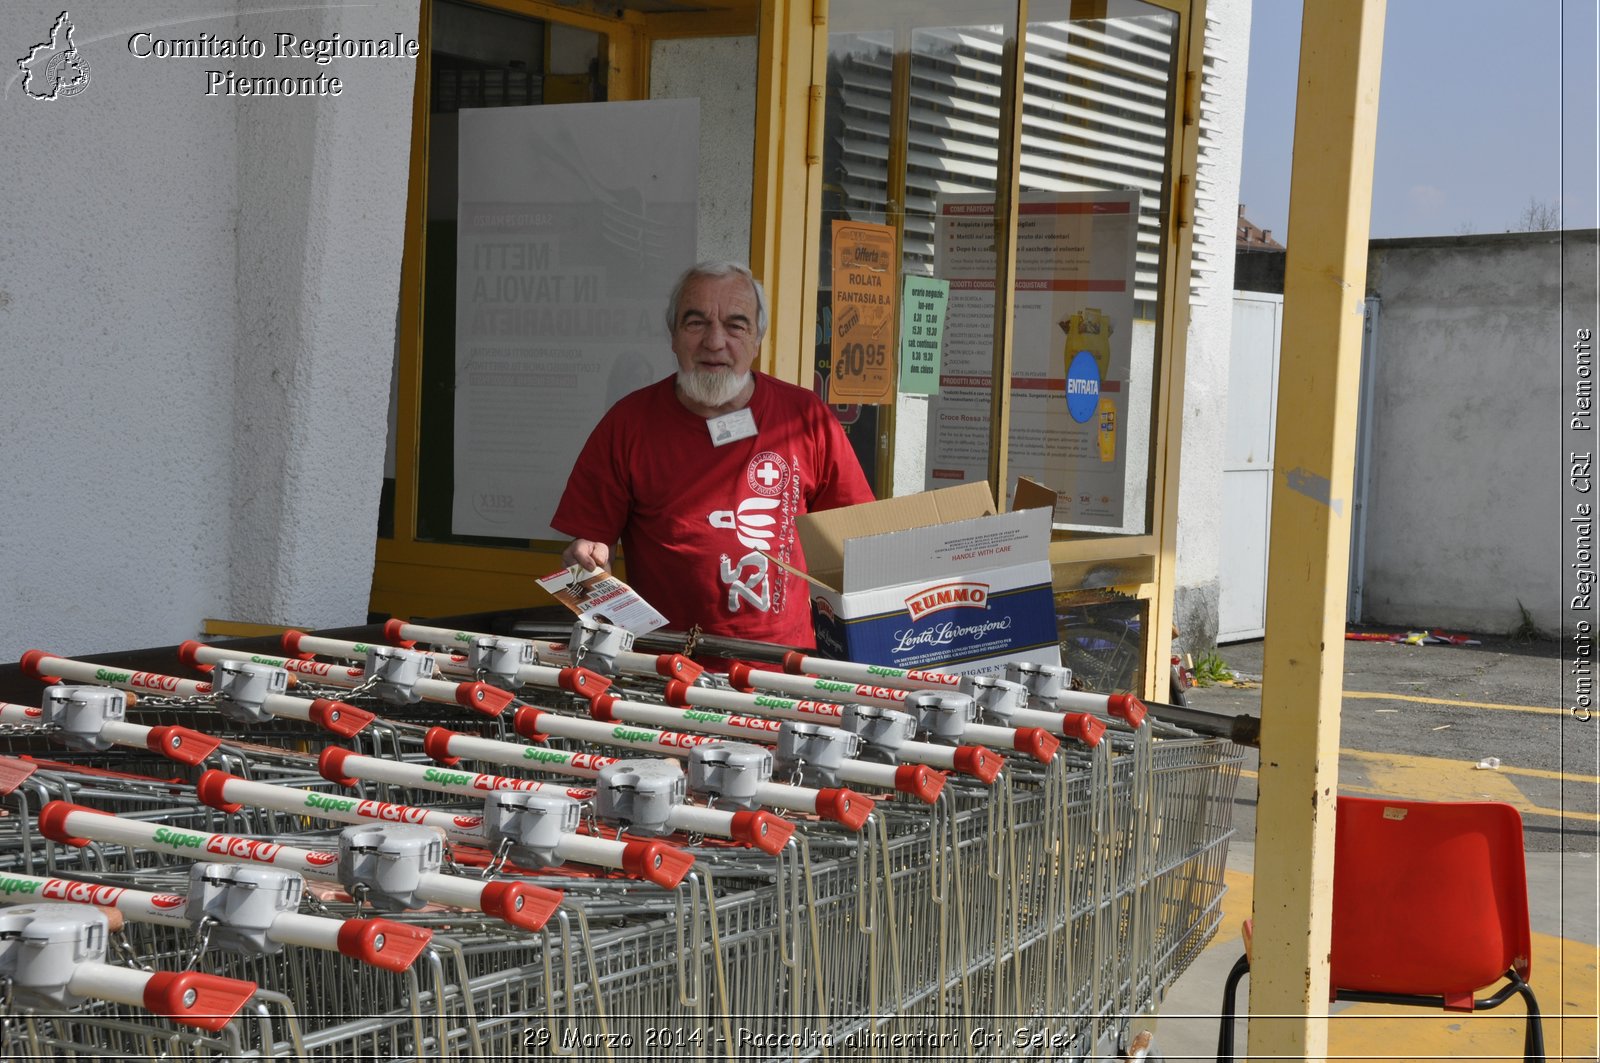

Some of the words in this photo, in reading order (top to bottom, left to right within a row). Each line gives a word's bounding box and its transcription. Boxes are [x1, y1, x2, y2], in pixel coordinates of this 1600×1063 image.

[855, 247, 879, 263] Offerta
[849, 273, 882, 287] ROLATA
[837, 291, 877, 304] FANTASIA
[838, 310, 860, 338] Carni
[1067, 378, 1099, 395] ENTRATA
[940, 413, 959, 421] Croce
[960, 414, 980, 422] Rossa
[778, 491, 790, 541] ITALIANA
[951, 551, 976, 561] HANDLE
[977, 548, 995, 558] WITH
[995, 545, 1011, 554] CARE
[580, 603, 591, 611] LA
[911, 588, 985, 615] RUMMO
[891, 627, 935, 654] Lenta
[930, 616, 1011, 646] Lavorazione
[95, 668, 131, 685] Super
[867, 664, 906, 678] Super
[961, 665, 992, 678] RIGATE
[814, 678, 856, 694] Super
[753, 695, 797, 711] Super
[682, 708, 728, 724] Super
[612, 726, 658, 743] Super
[522, 747, 570, 765] Super
[422, 768, 473, 787] Super
[304, 793, 357, 813] Super
[152, 827, 206, 849] Super
[0, 875, 43, 895] uper
